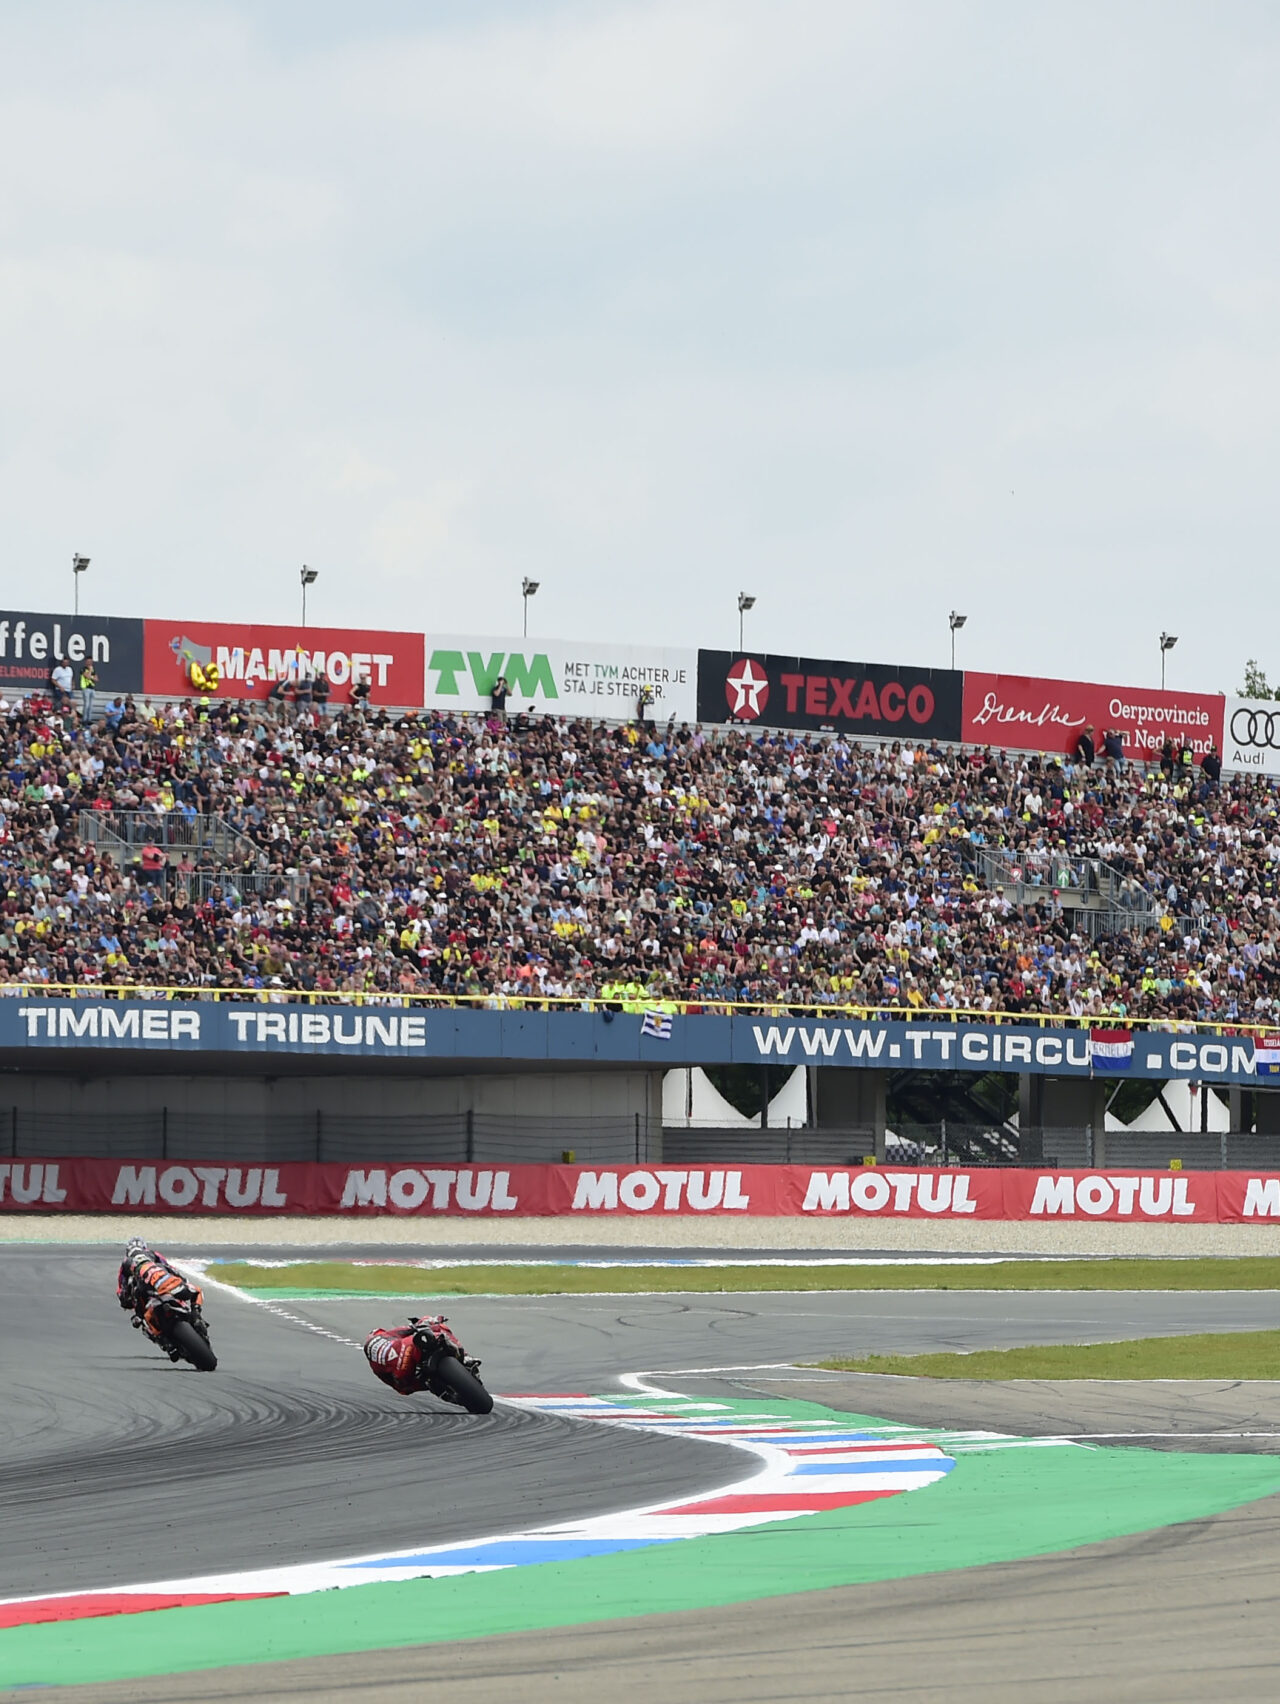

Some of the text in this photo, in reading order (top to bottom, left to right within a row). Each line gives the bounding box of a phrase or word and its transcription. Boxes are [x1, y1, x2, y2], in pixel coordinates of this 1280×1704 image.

[217, 645, 394, 687] MAMMOET
[428, 650, 559, 699] TVM
[564, 661, 687, 684] MET TVM ACHTER JE
[564, 679, 587, 693] STA
[589, 681, 604, 695] JE
[781, 674, 935, 724] TEXACO
[1109, 698, 1210, 726] Oerprovincie
[1232, 750, 1265, 765] Audi
[19, 1007, 200, 1040] TIMMER
[228, 1011, 426, 1047] TRIBUNE
[752, 1025, 1256, 1075] WWW.TTCIRCU.COM
[111, 1165, 288, 1208] MOTUL
[340, 1168, 518, 1211] MOTUL
[572, 1171, 750, 1211] MOTUL
[802, 1172, 977, 1214] MOTUL
[1029, 1175, 1196, 1216] MOTUL
